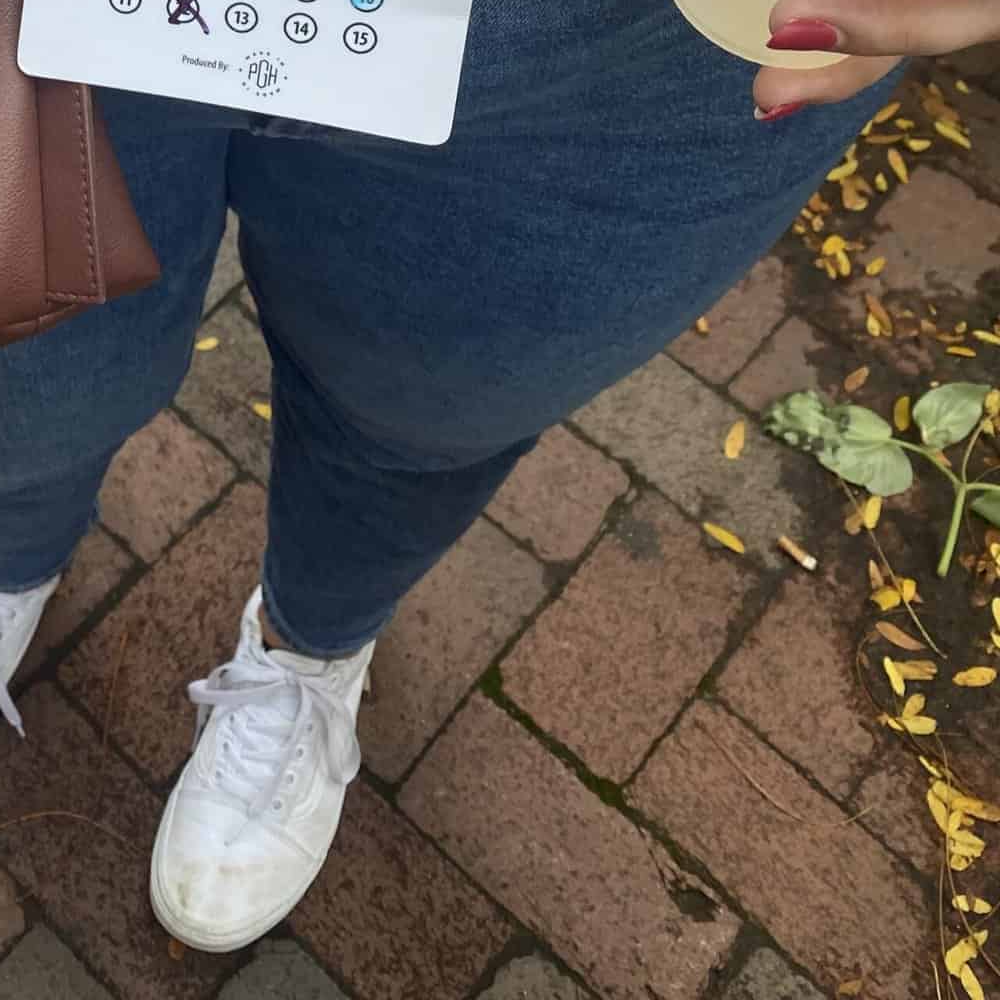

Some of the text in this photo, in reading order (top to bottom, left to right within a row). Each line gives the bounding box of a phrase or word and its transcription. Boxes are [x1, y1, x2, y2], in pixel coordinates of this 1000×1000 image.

[234, 10, 250, 25] 13
[293, 21, 309, 36] 14
[352, 31, 369, 46] 15
[182, 54, 217, 69] Produced
[248, 59, 278, 89] PGH
